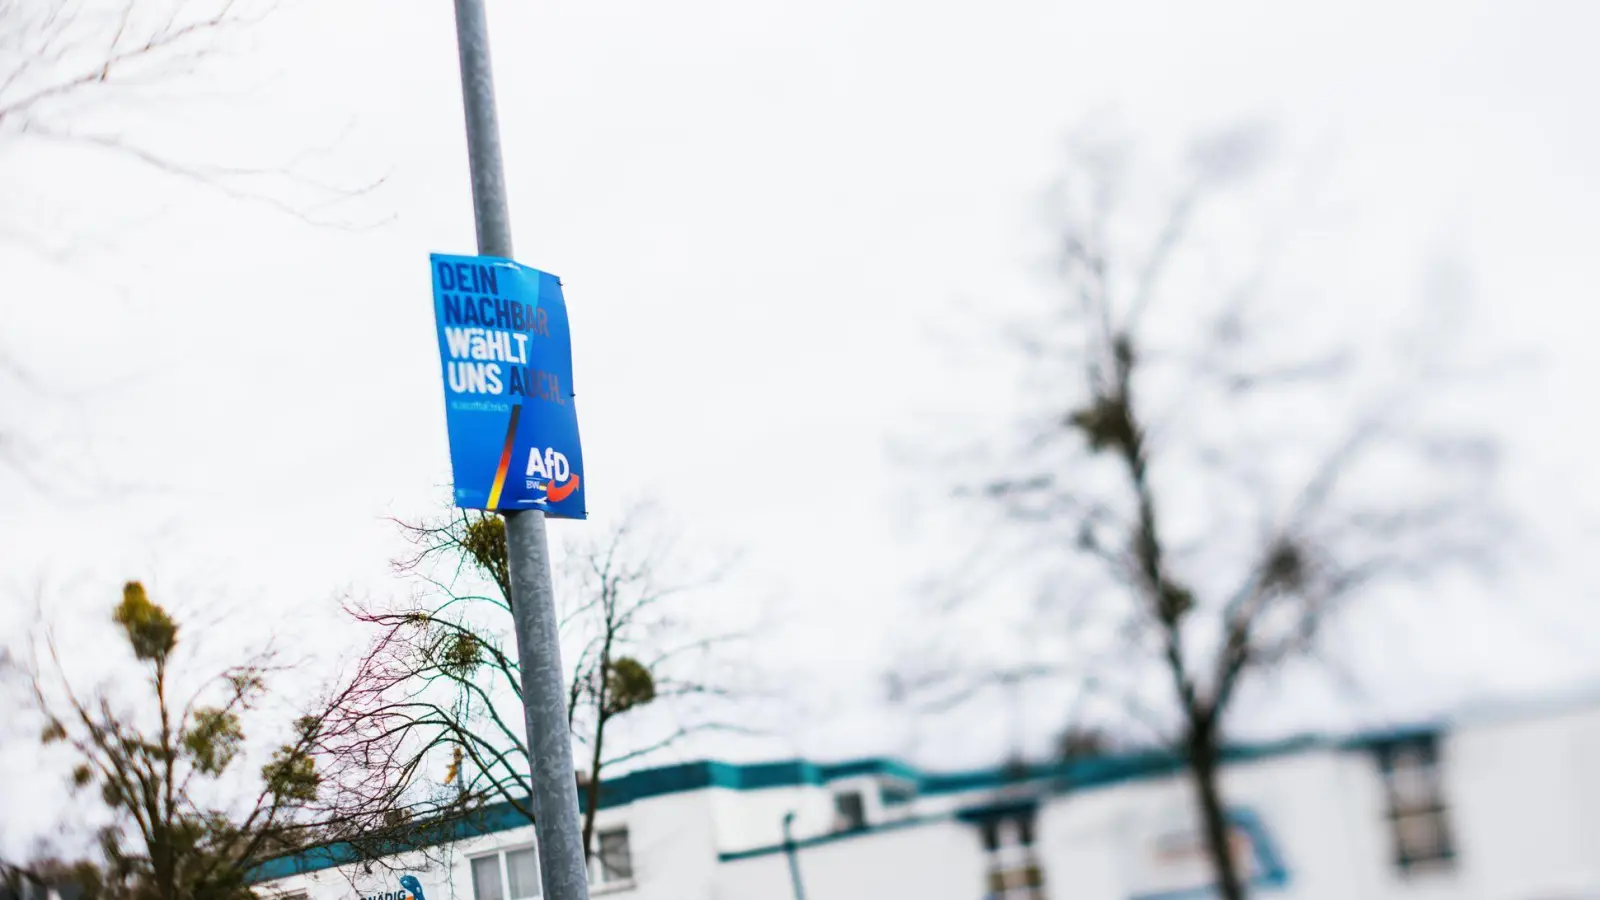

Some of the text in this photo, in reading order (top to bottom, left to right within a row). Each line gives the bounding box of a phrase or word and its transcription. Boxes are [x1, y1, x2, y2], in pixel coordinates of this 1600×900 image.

[438, 261, 499, 295] DEIN
[443, 294, 549, 338] NACHBAR
[448, 361, 565, 405] UNS AUCH.
[526, 447, 570, 482] AfD
[360, 890, 406, 900] ÄDIG
